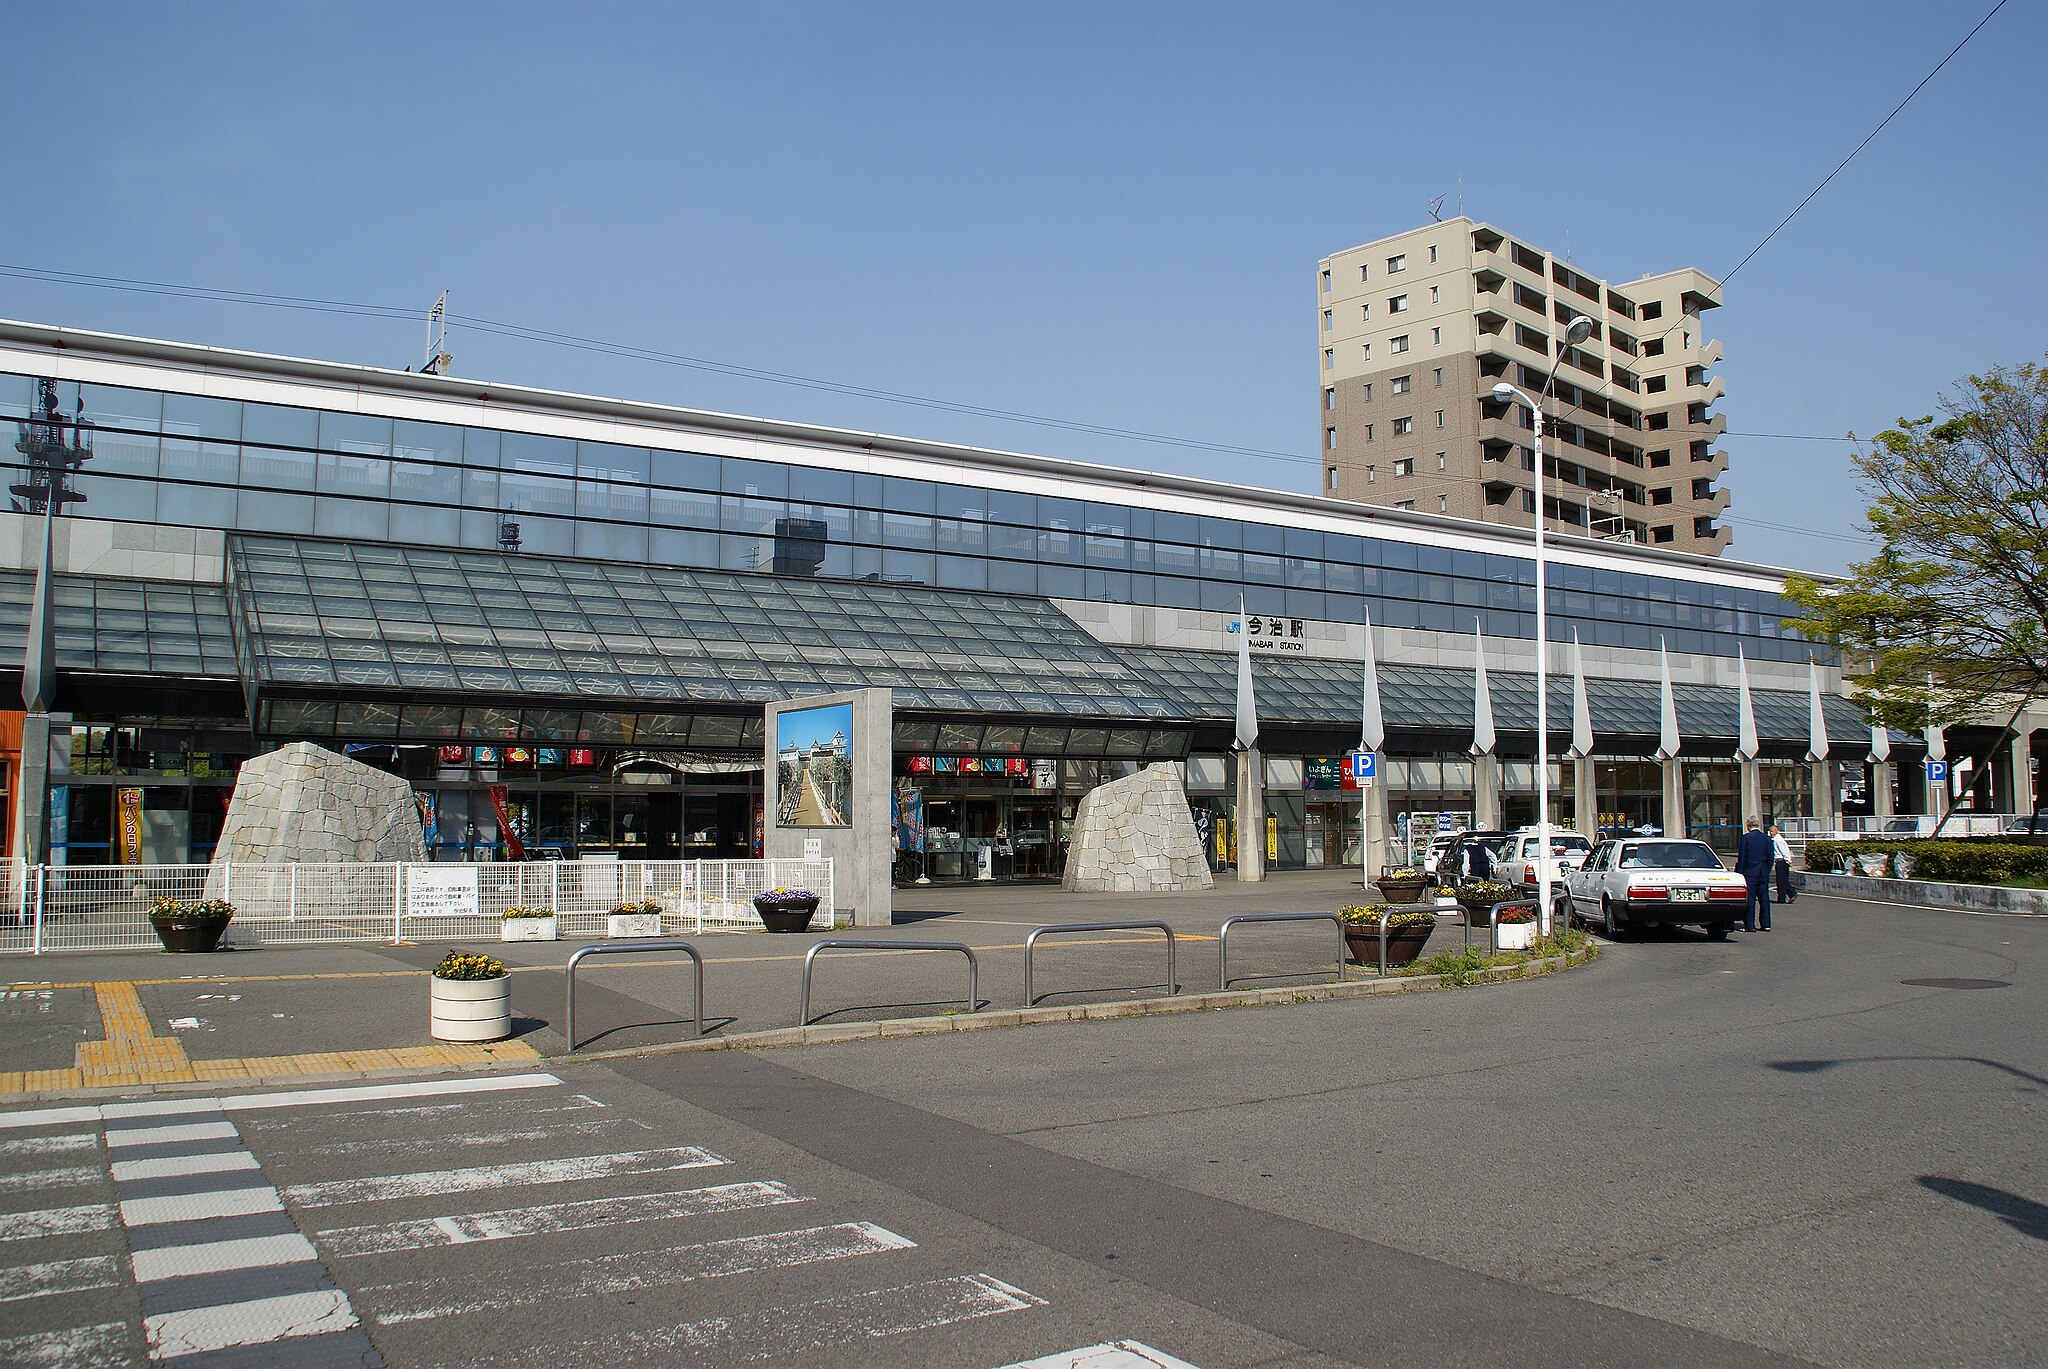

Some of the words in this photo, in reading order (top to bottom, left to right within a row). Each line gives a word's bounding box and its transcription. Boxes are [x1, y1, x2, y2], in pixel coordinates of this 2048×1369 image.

[1248, 616, 1304, 638] 今治駅
[1248, 639, 1274, 649] MABARI
[1279, 641, 1304, 651] STATION
[1308, 765, 1332, 774] いよぎん
[1358, 755, 1372, 776] P
[1931, 763, 1944, 779] P
